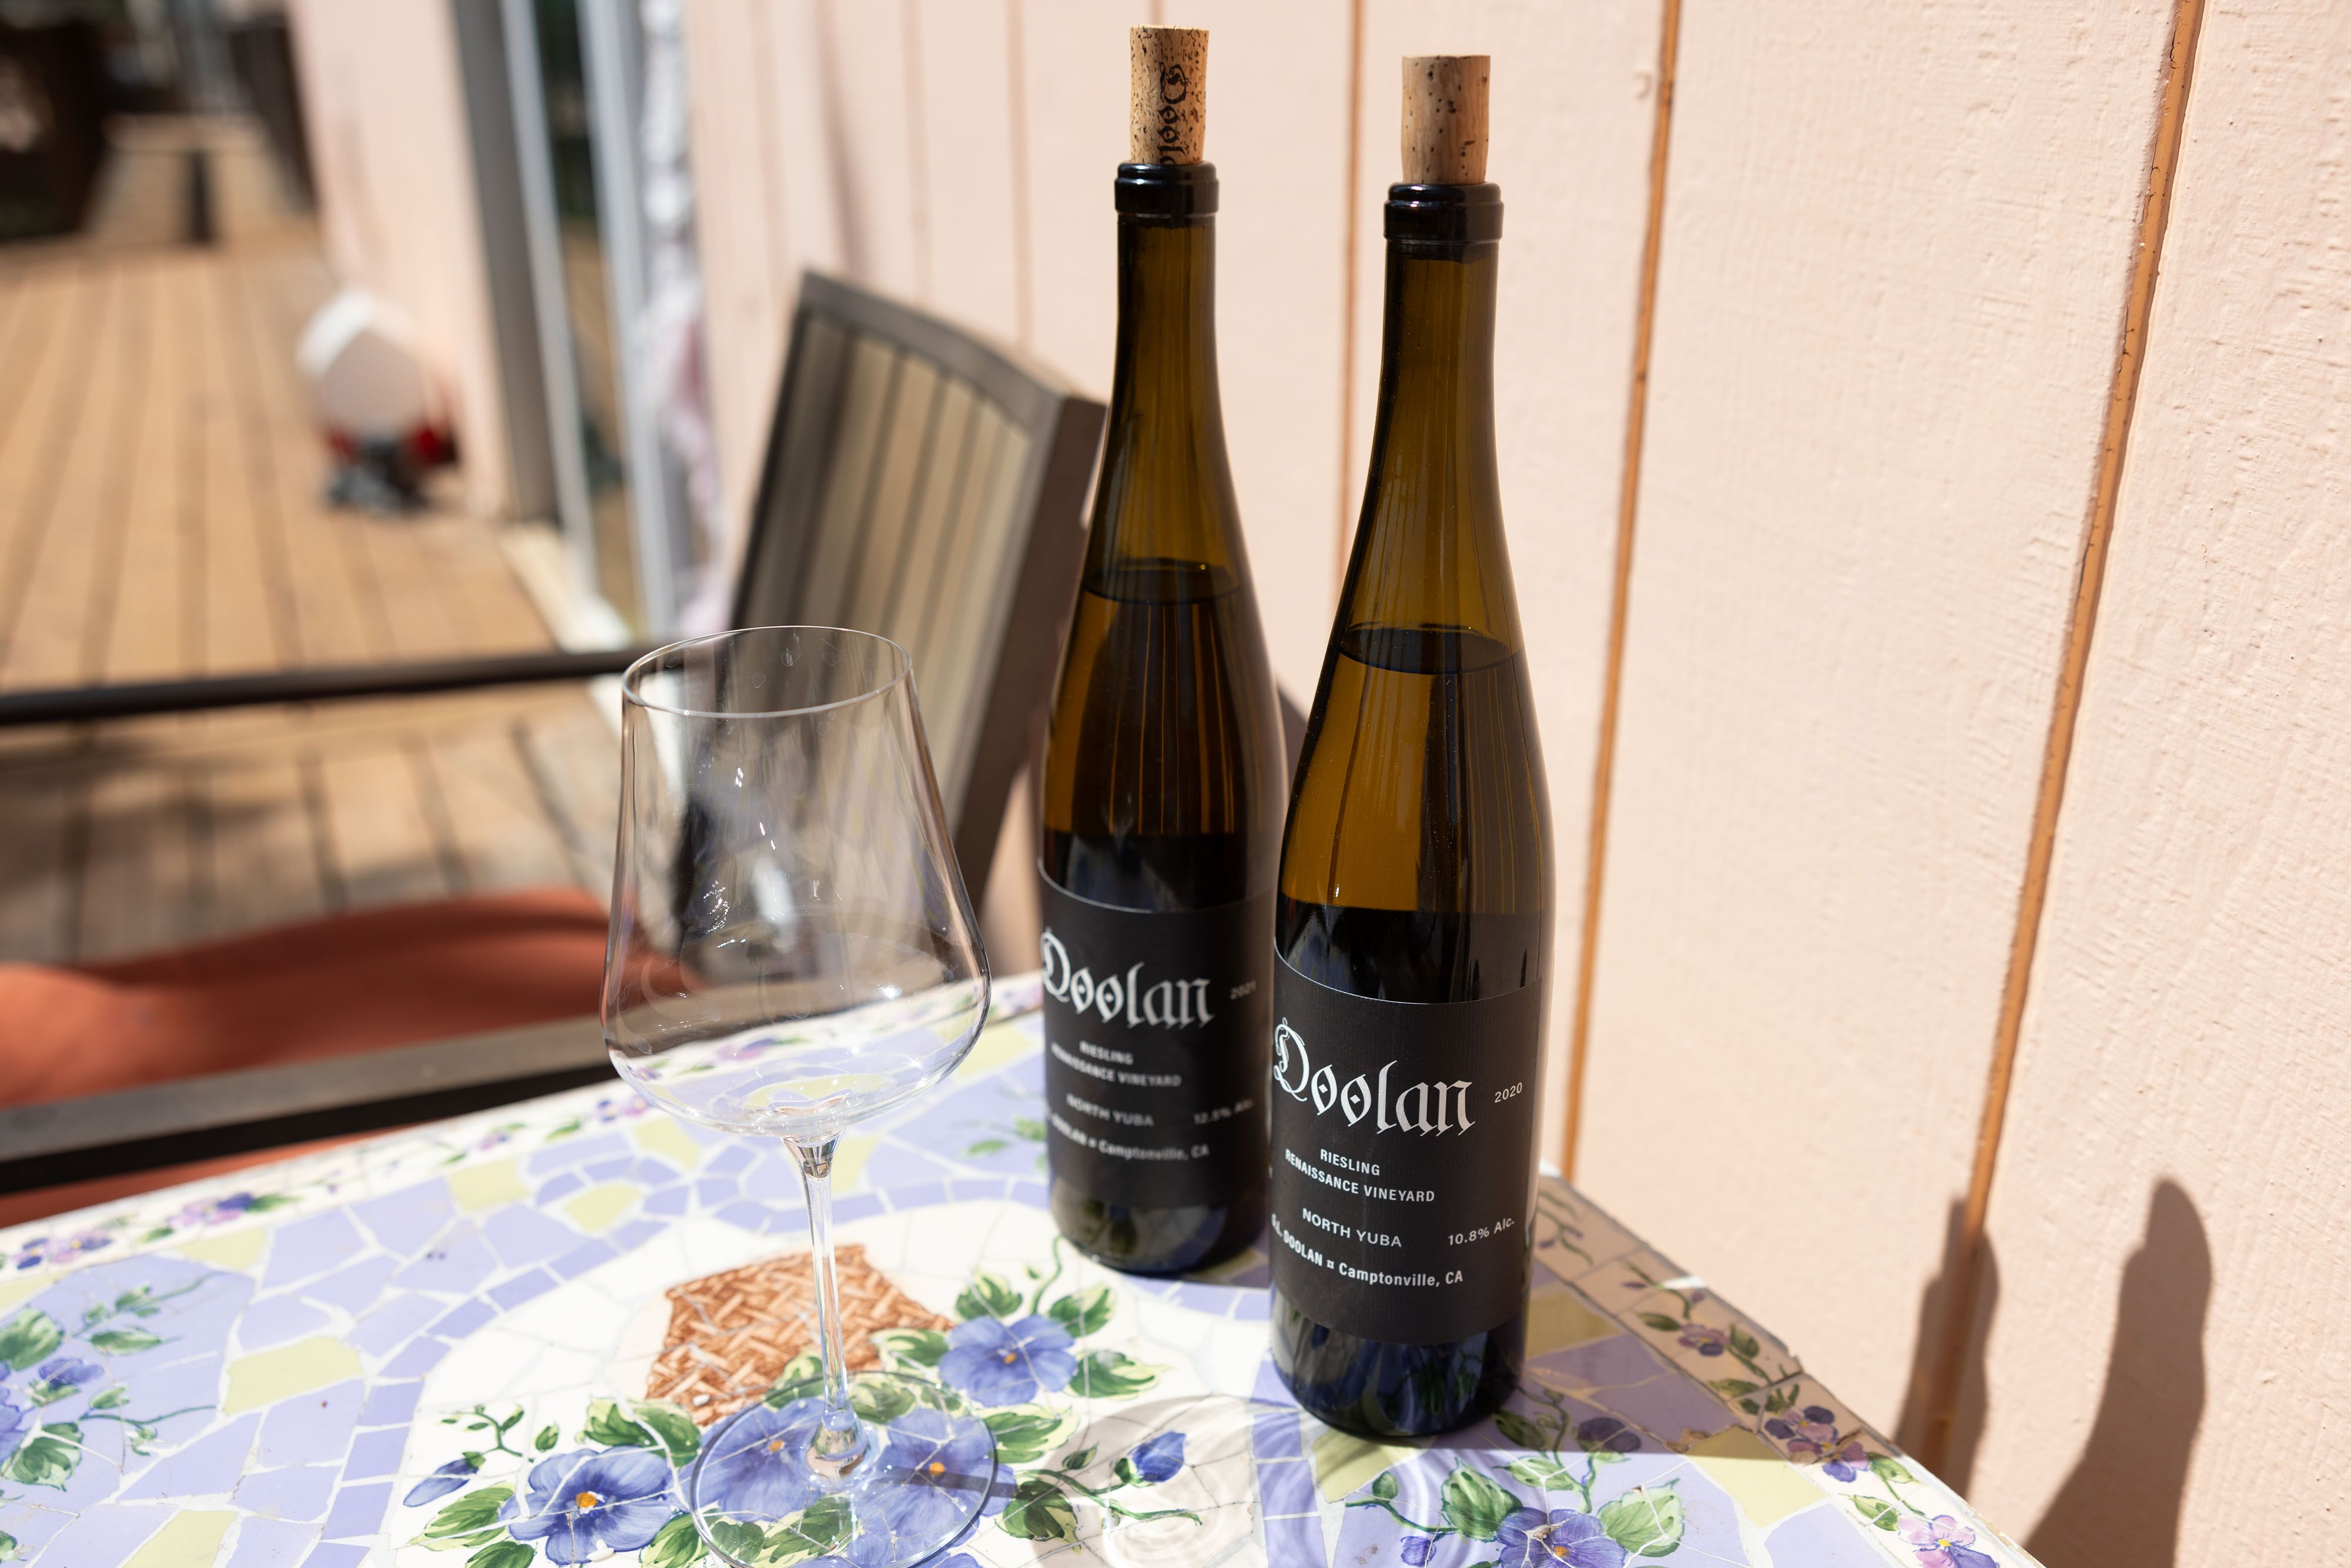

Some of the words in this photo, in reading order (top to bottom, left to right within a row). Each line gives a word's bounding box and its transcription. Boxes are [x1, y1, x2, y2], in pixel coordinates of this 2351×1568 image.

[1040, 926, 1215, 1029] Doolan
[1079, 1040, 1134, 1066] RIESLING
[1117, 1071, 1182, 1087] VINEYARD
[1273, 1017, 1475, 1137] Doolan
[1494, 1082, 1523, 1104] 2020
[1066, 1093, 1110, 1121] NORTH
[1112, 1109, 1154, 1127] YUBA
[1190, 1144, 1210, 1159] CA
[1320, 1148, 1380, 1176] RIESLING
[1285, 1148, 1359, 1194] RENAISSANCE
[1364, 1184, 1435, 1202] VINEYARD
[1302, 1207, 1351, 1239] NORTH
[1356, 1229, 1402, 1248] YUBA
[1448, 1227, 1490, 1246] 10.8%
[1494, 1217, 1515, 1234] Alc.
[1283, 1229, 1323, 1267] DOOLAN
[1339, 1262, 1440, 1288] Camptonville,
[1445, 1270, 1463, 1285] CA
